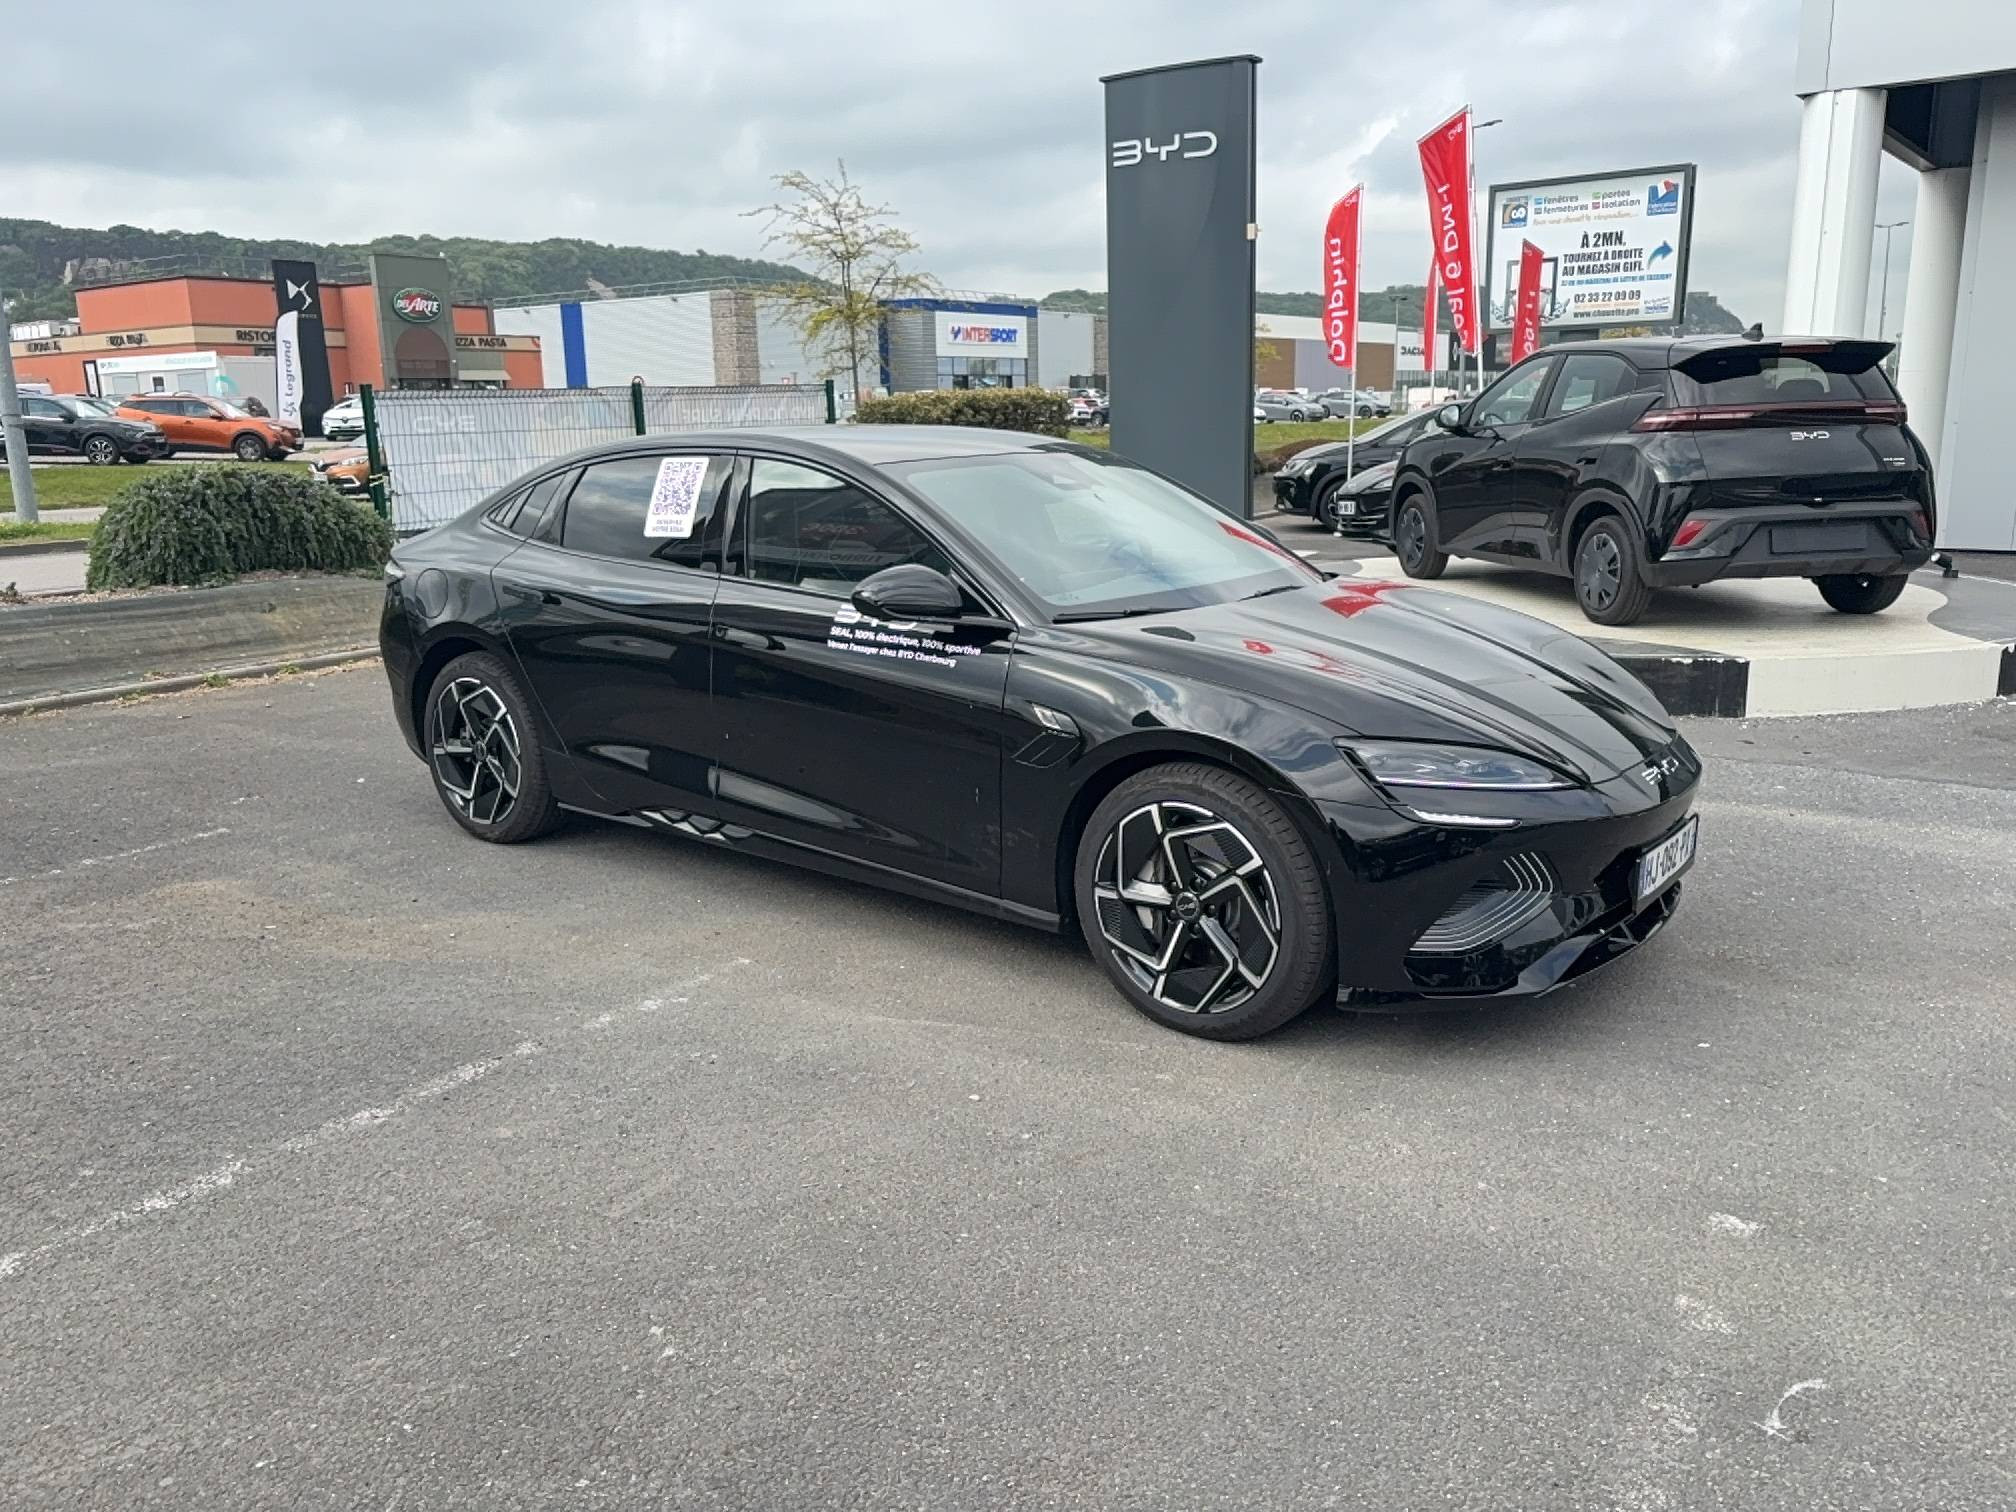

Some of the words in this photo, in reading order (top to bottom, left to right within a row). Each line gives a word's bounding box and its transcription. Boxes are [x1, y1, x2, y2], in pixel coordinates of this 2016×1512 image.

[1112, 130, 1218, 167] BYD
[1601, 191, 1631, 200] portes
[1563, 252, 1603, 264] TOURNEZ
[1611, 248, 1643, 261] DROITE
[1562, 265, 1575, 277] AU
[1577, 262, 1621, 275] MAGASIN
[478, 336, 507, 348] PASTA
[961, 326, 1018, 344] INTERSPORT
[1789, 430, 1831, 441] BYD
[854, 629, 875, 641] 100%
[921, 638, 945, 651] 100%
[944, 643, 982, 656] sportive
